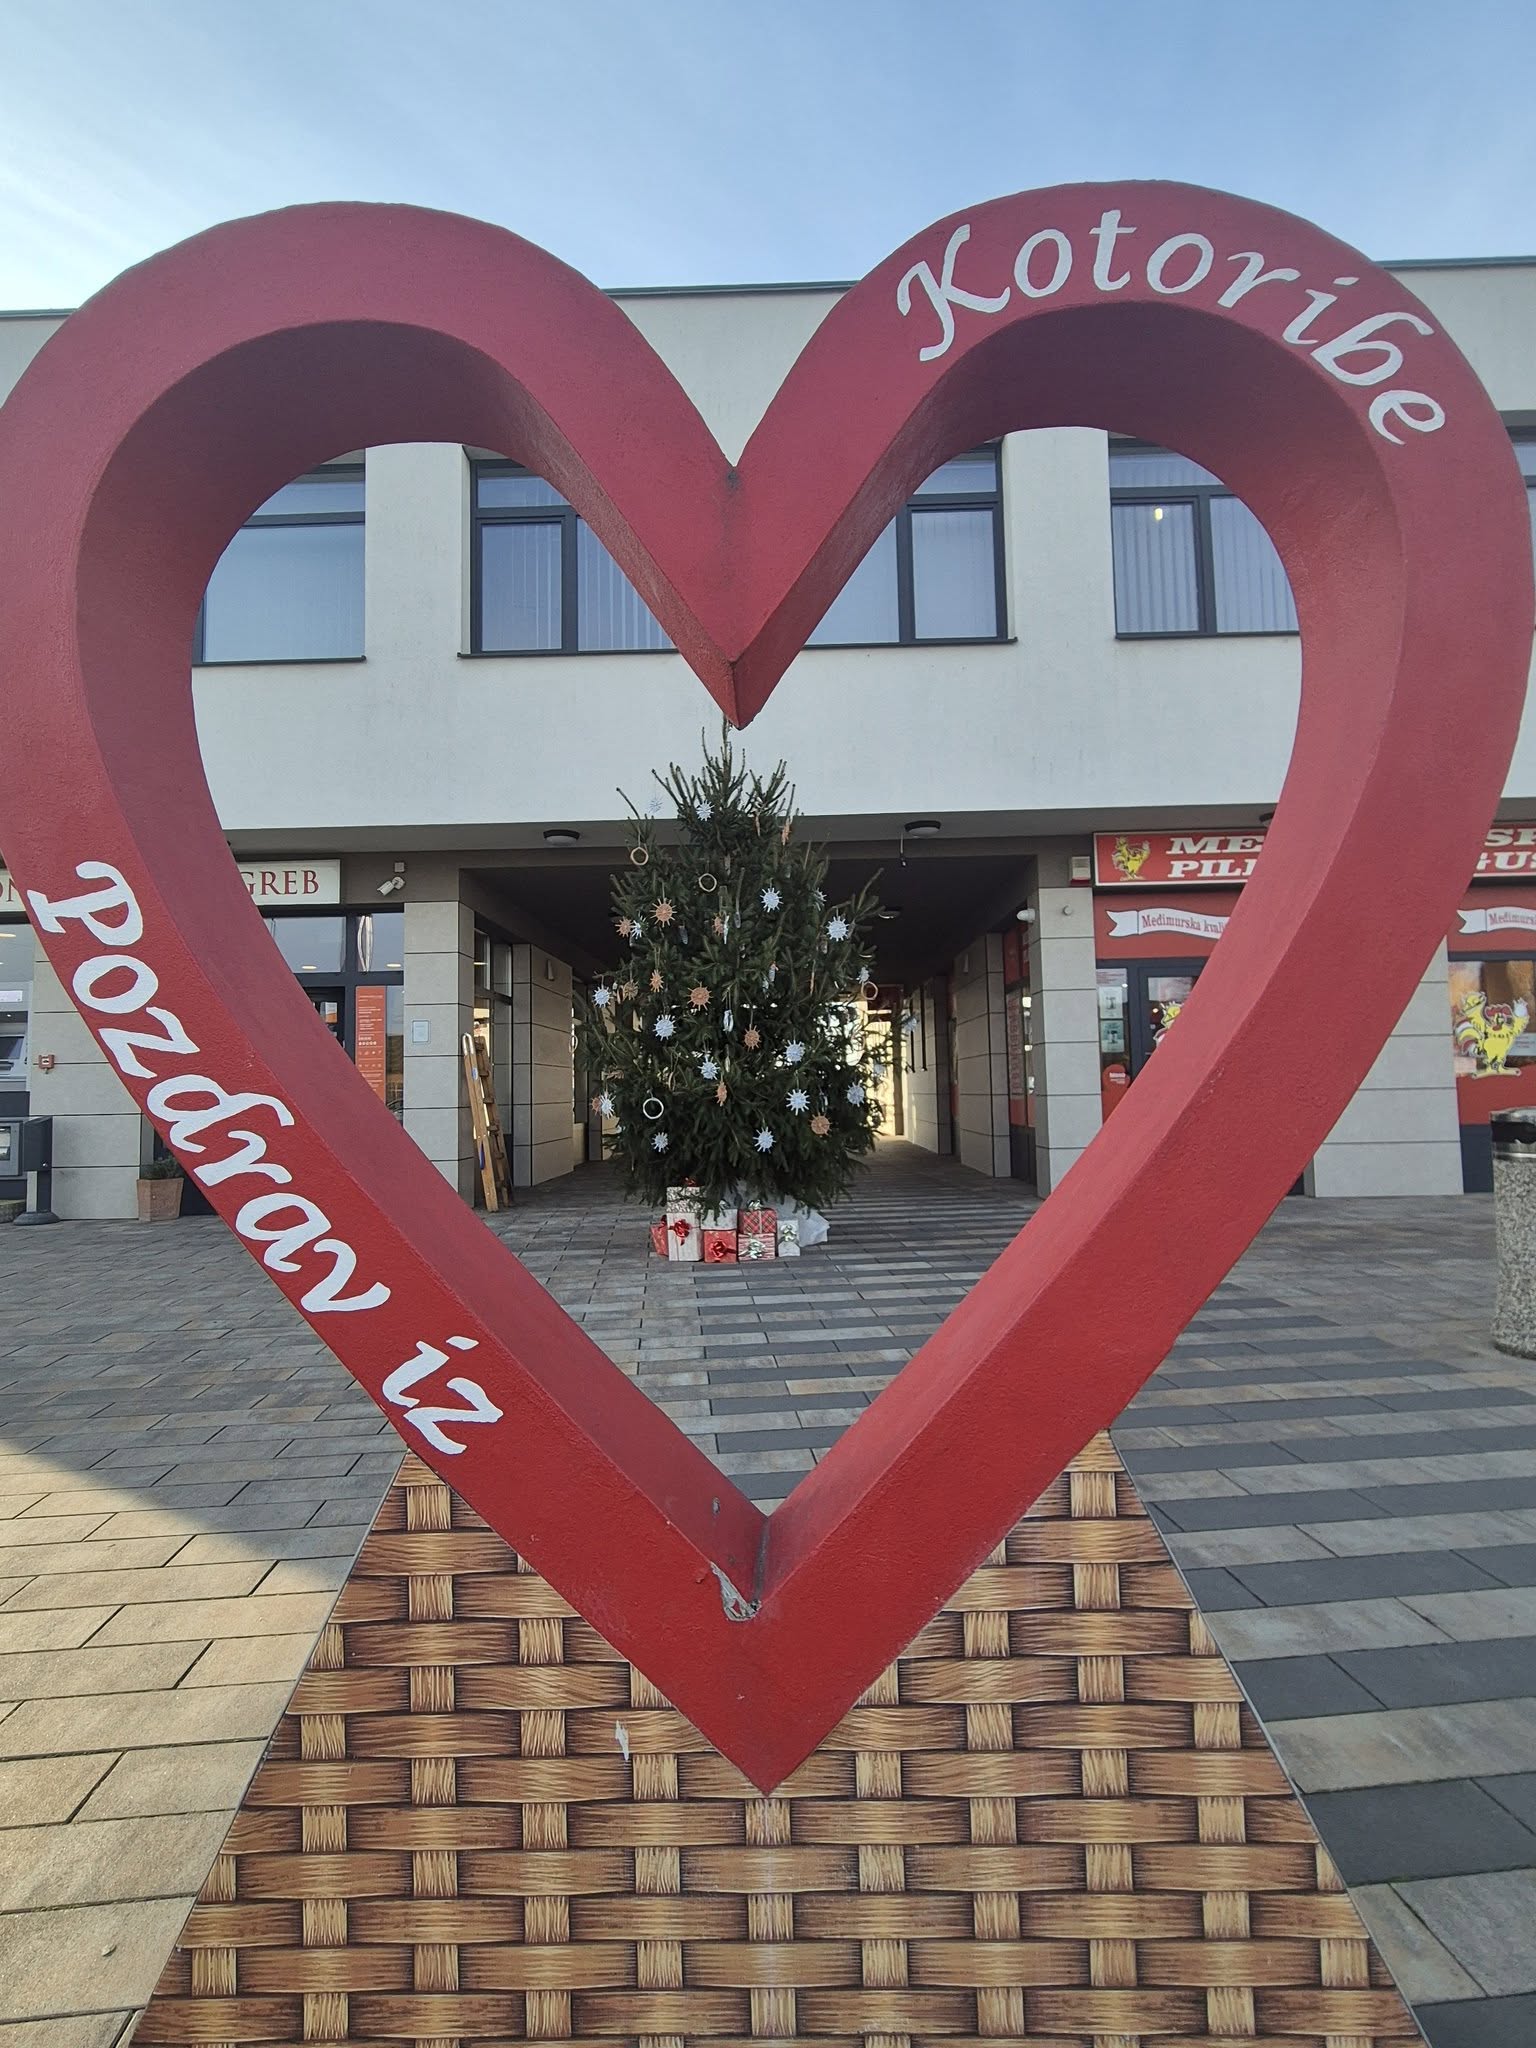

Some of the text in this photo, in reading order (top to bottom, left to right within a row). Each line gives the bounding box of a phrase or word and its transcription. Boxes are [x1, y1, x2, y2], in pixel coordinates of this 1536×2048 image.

[897, 209, 1445, 445] Kotoribe
[27, 861, 503, 1455] Pozdrav iz
